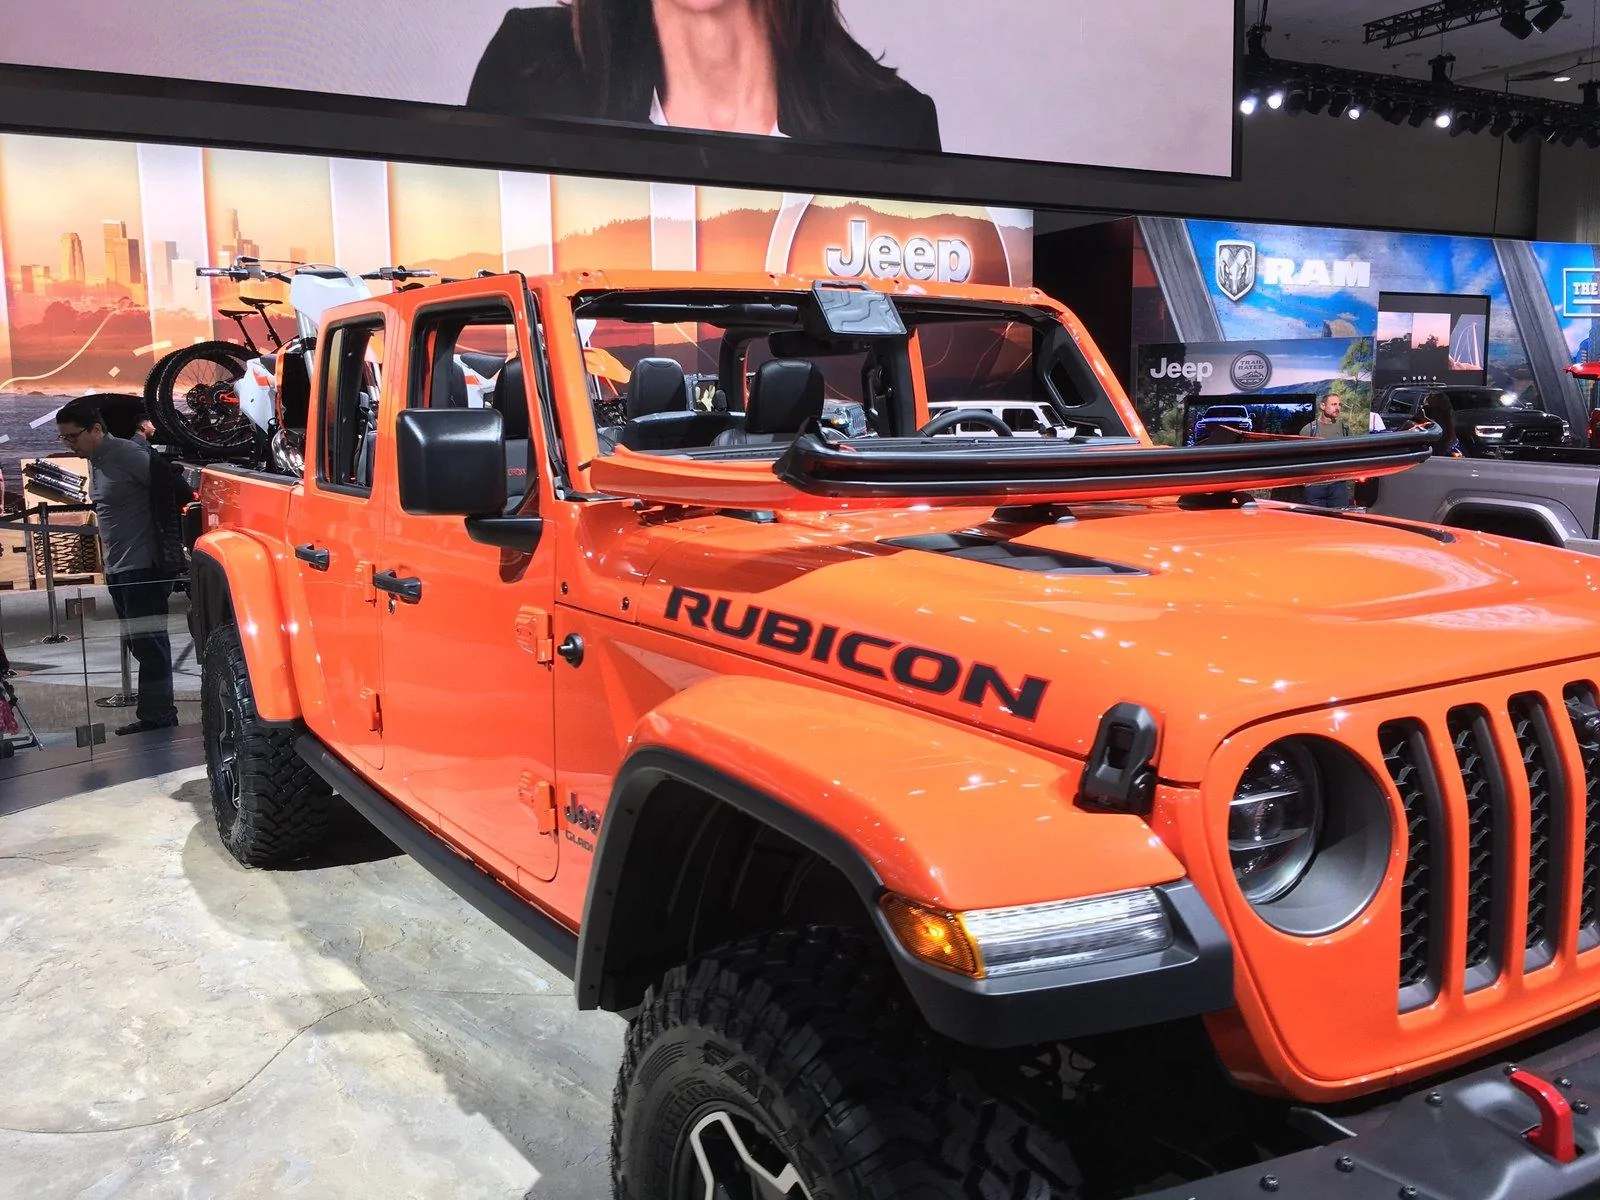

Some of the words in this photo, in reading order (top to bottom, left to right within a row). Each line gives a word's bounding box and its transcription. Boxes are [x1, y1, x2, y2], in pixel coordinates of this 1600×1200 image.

[826, 220, 972, 283] Jeep
[1263, 256, 1370, 288] RAM
[1572, 282, 1599, 296] THE
[1149, 357, 1213, 382] Jeep
[664, 586, 1051, 722] RUBICON
[564, 792, 600, 835] Jee
[565, 829, 594, 853] GLADI
